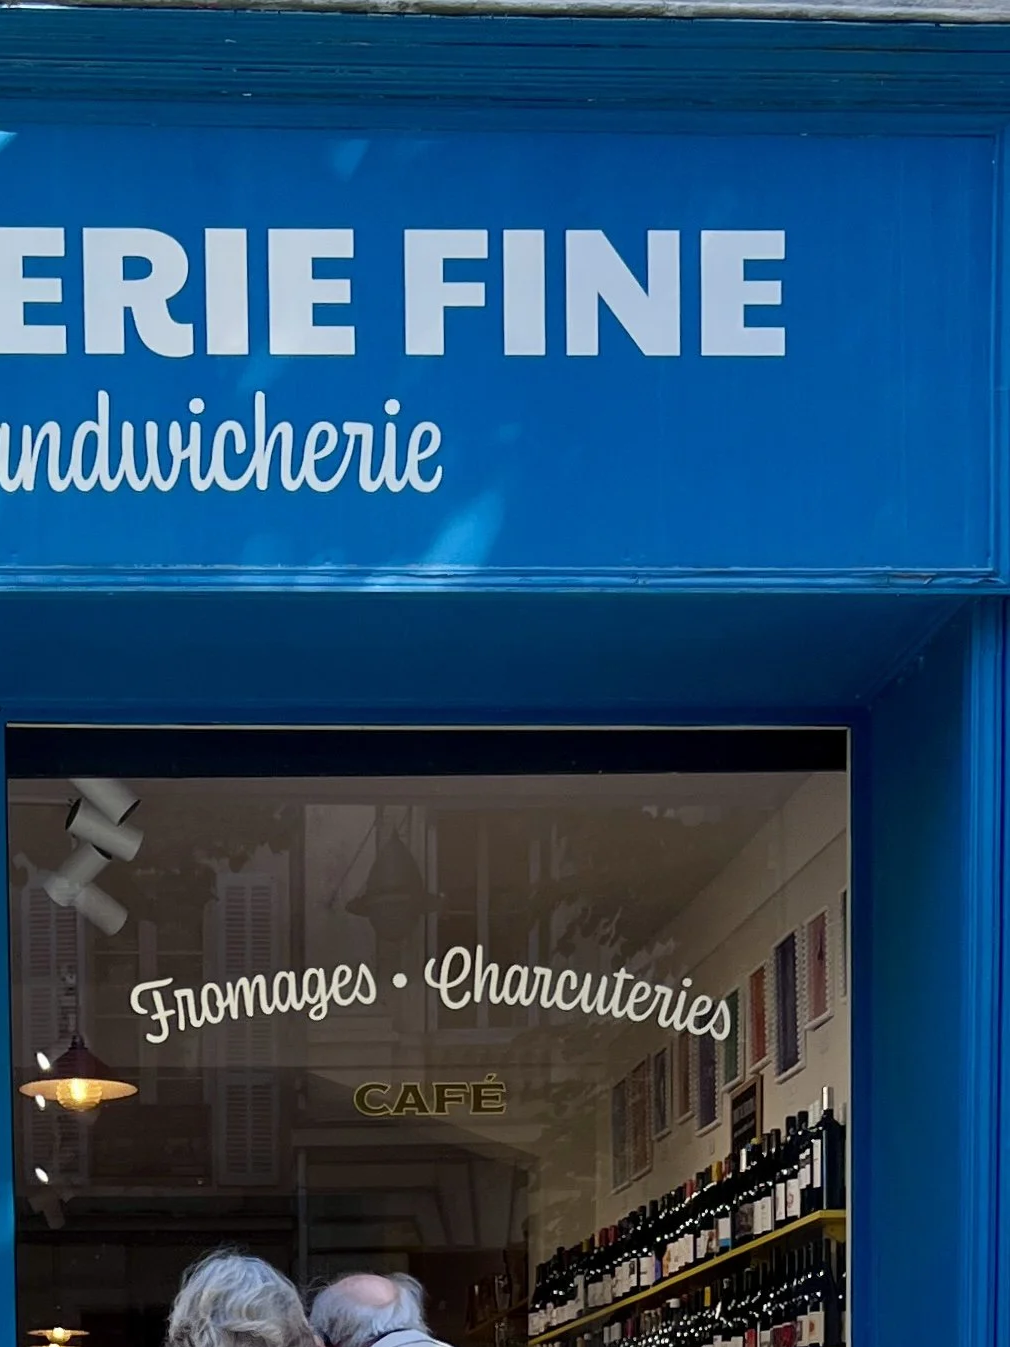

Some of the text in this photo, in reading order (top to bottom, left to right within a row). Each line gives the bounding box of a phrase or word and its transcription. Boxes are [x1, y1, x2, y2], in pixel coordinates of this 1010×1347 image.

[404, 228, 787, 358] FINE
[130, 944, 732, 1045] Fromages Charcuteries
[353, 1072, 507, 1117] CAFÉ
